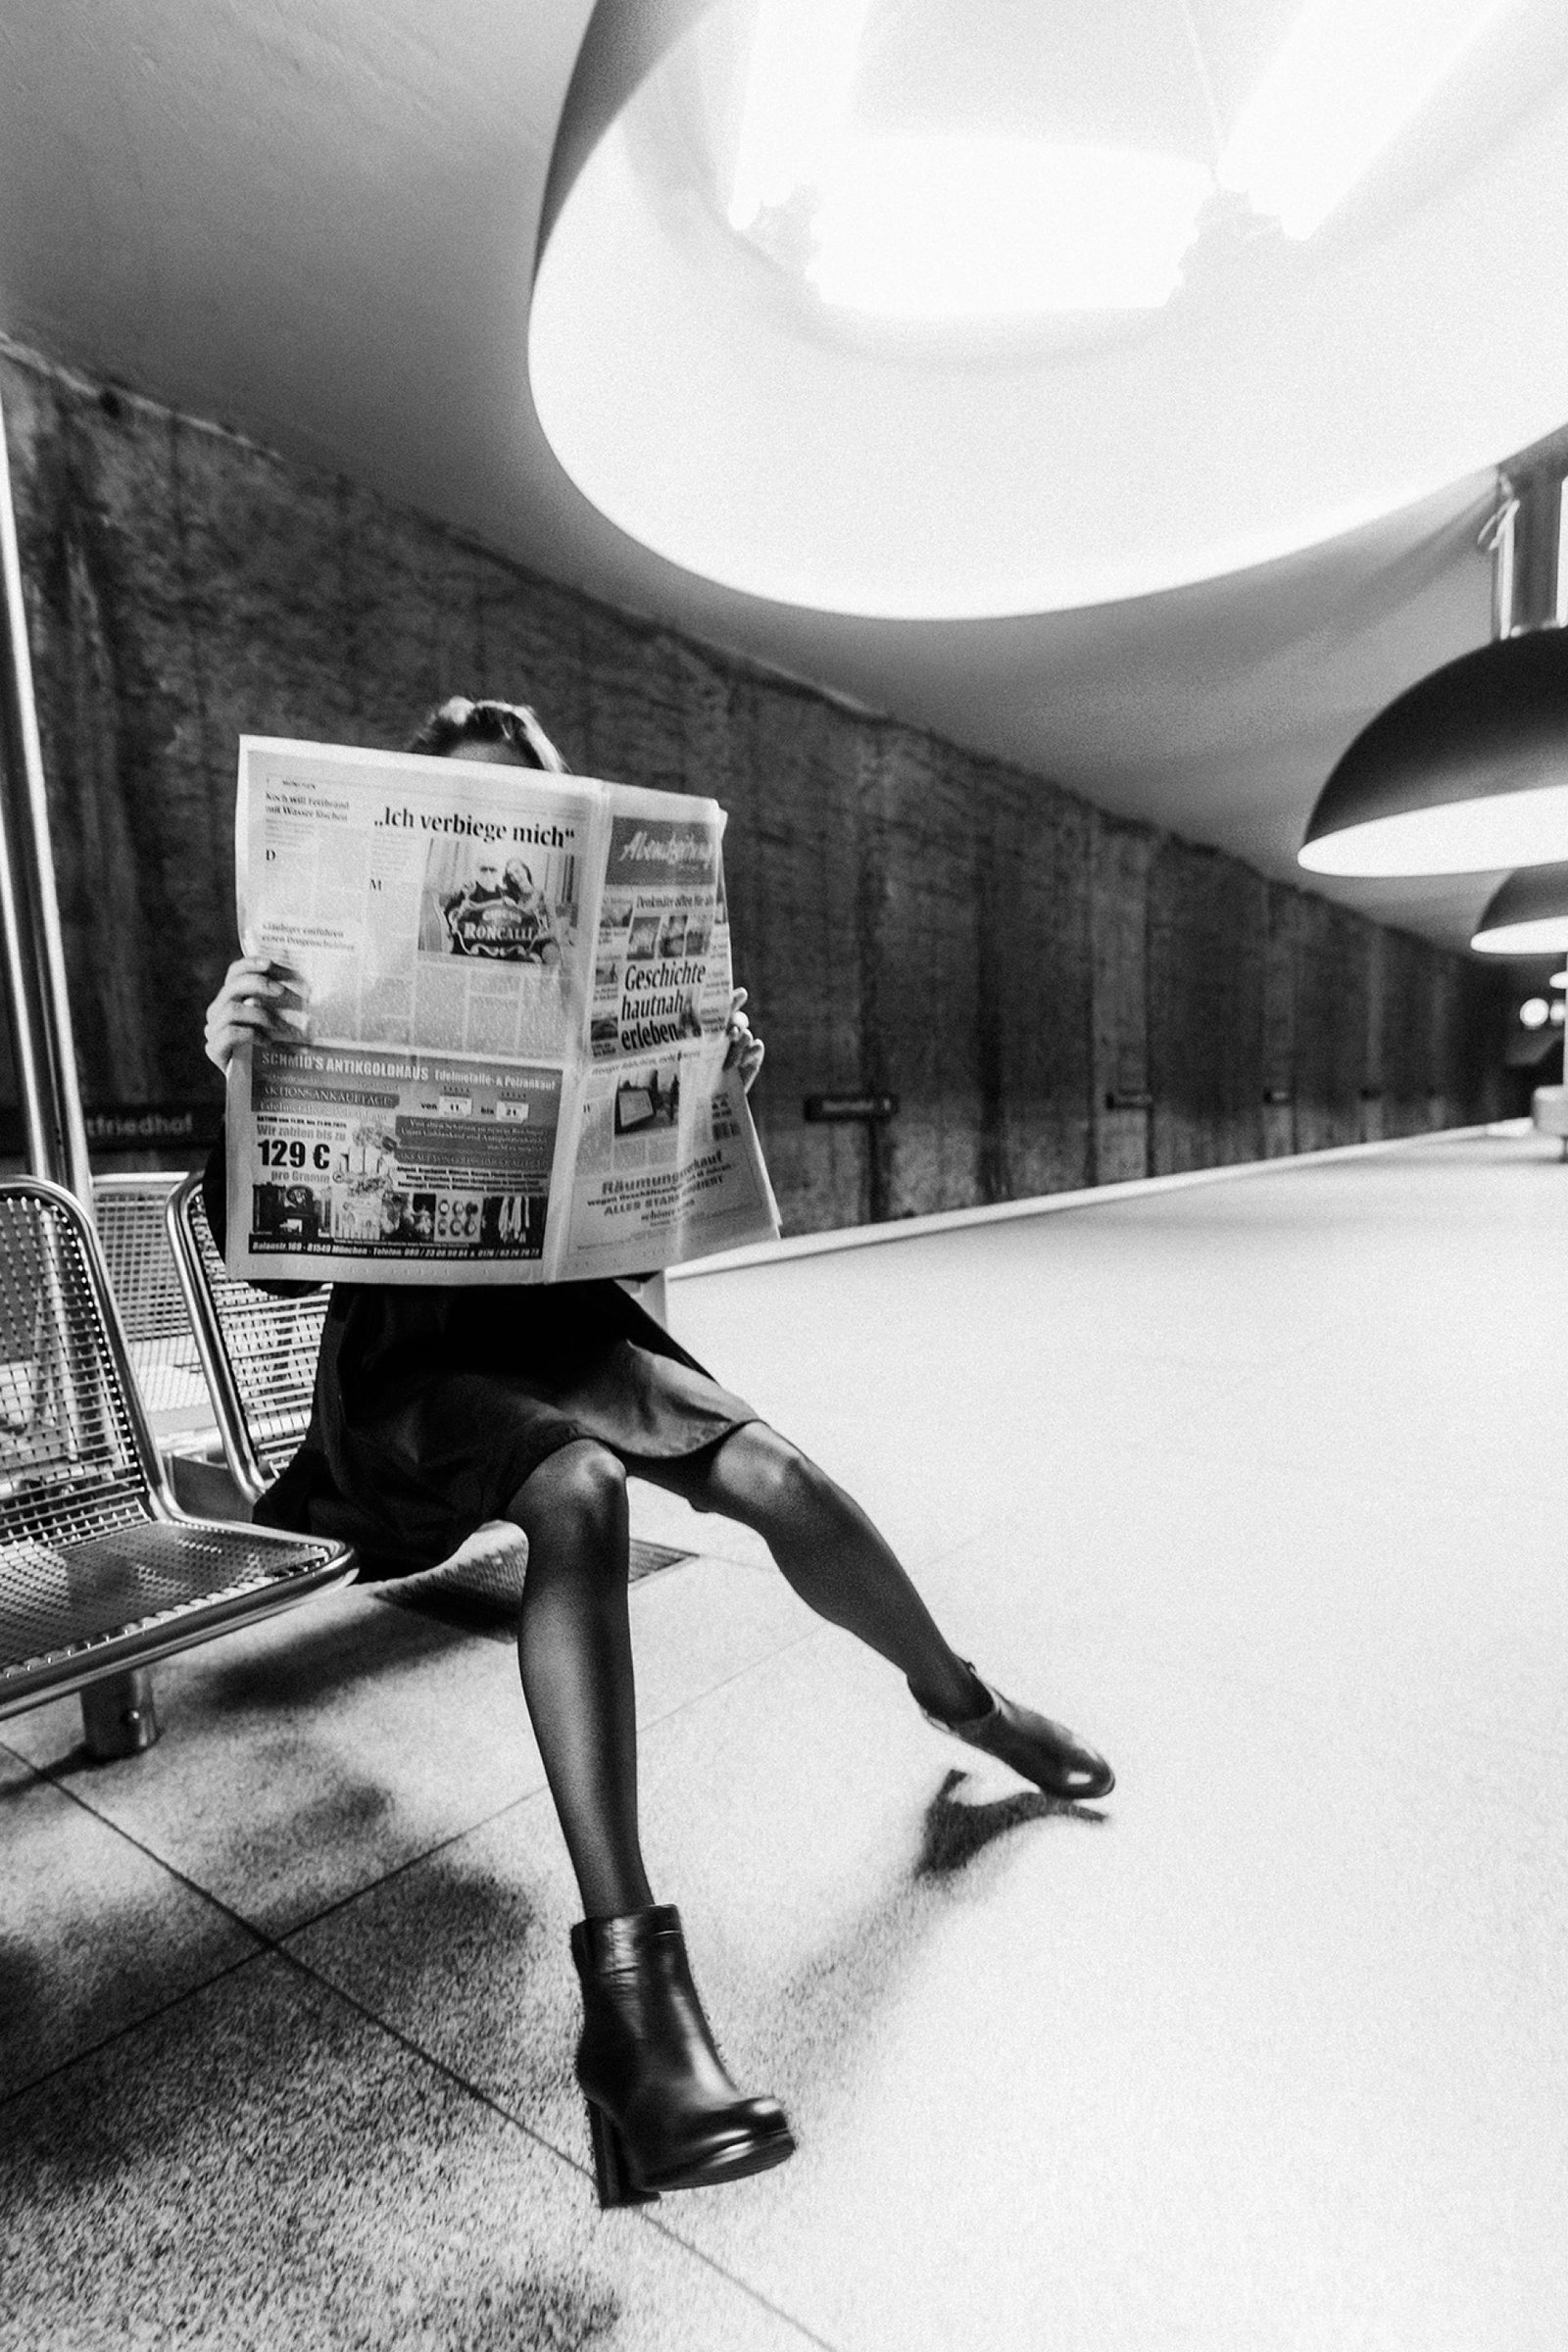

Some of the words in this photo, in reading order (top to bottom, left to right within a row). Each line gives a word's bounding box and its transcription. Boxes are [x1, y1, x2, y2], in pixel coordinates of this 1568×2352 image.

[420, 813, 508, 845] verbiege
[266, 849, 276, 860] D
[624, 960, 707, 992] Geschichte
[621, 989, 684, 1021] hautnah
[620, 1020, 680, 1052] erleben
[262, 1053, 324, 1070] SCHMID'S
[325, 1058, 429, 1081] ANTIKGOLDHAUS
[86, 1112, 193, 1137] tfriedhof
[257, 1124, 275, 1137] Wir
[278, 1126, 316, 1140] zahlen
[317, 1128, 333, 1141] bis
[335, 1131, 347, 1142] zu
[256, 1139, 307, 1169] 129
[313, 1143, 331, 1170] €
[270, 1170, 291, 1183] pro
[292, 1170, 331, 1184] Gramm
